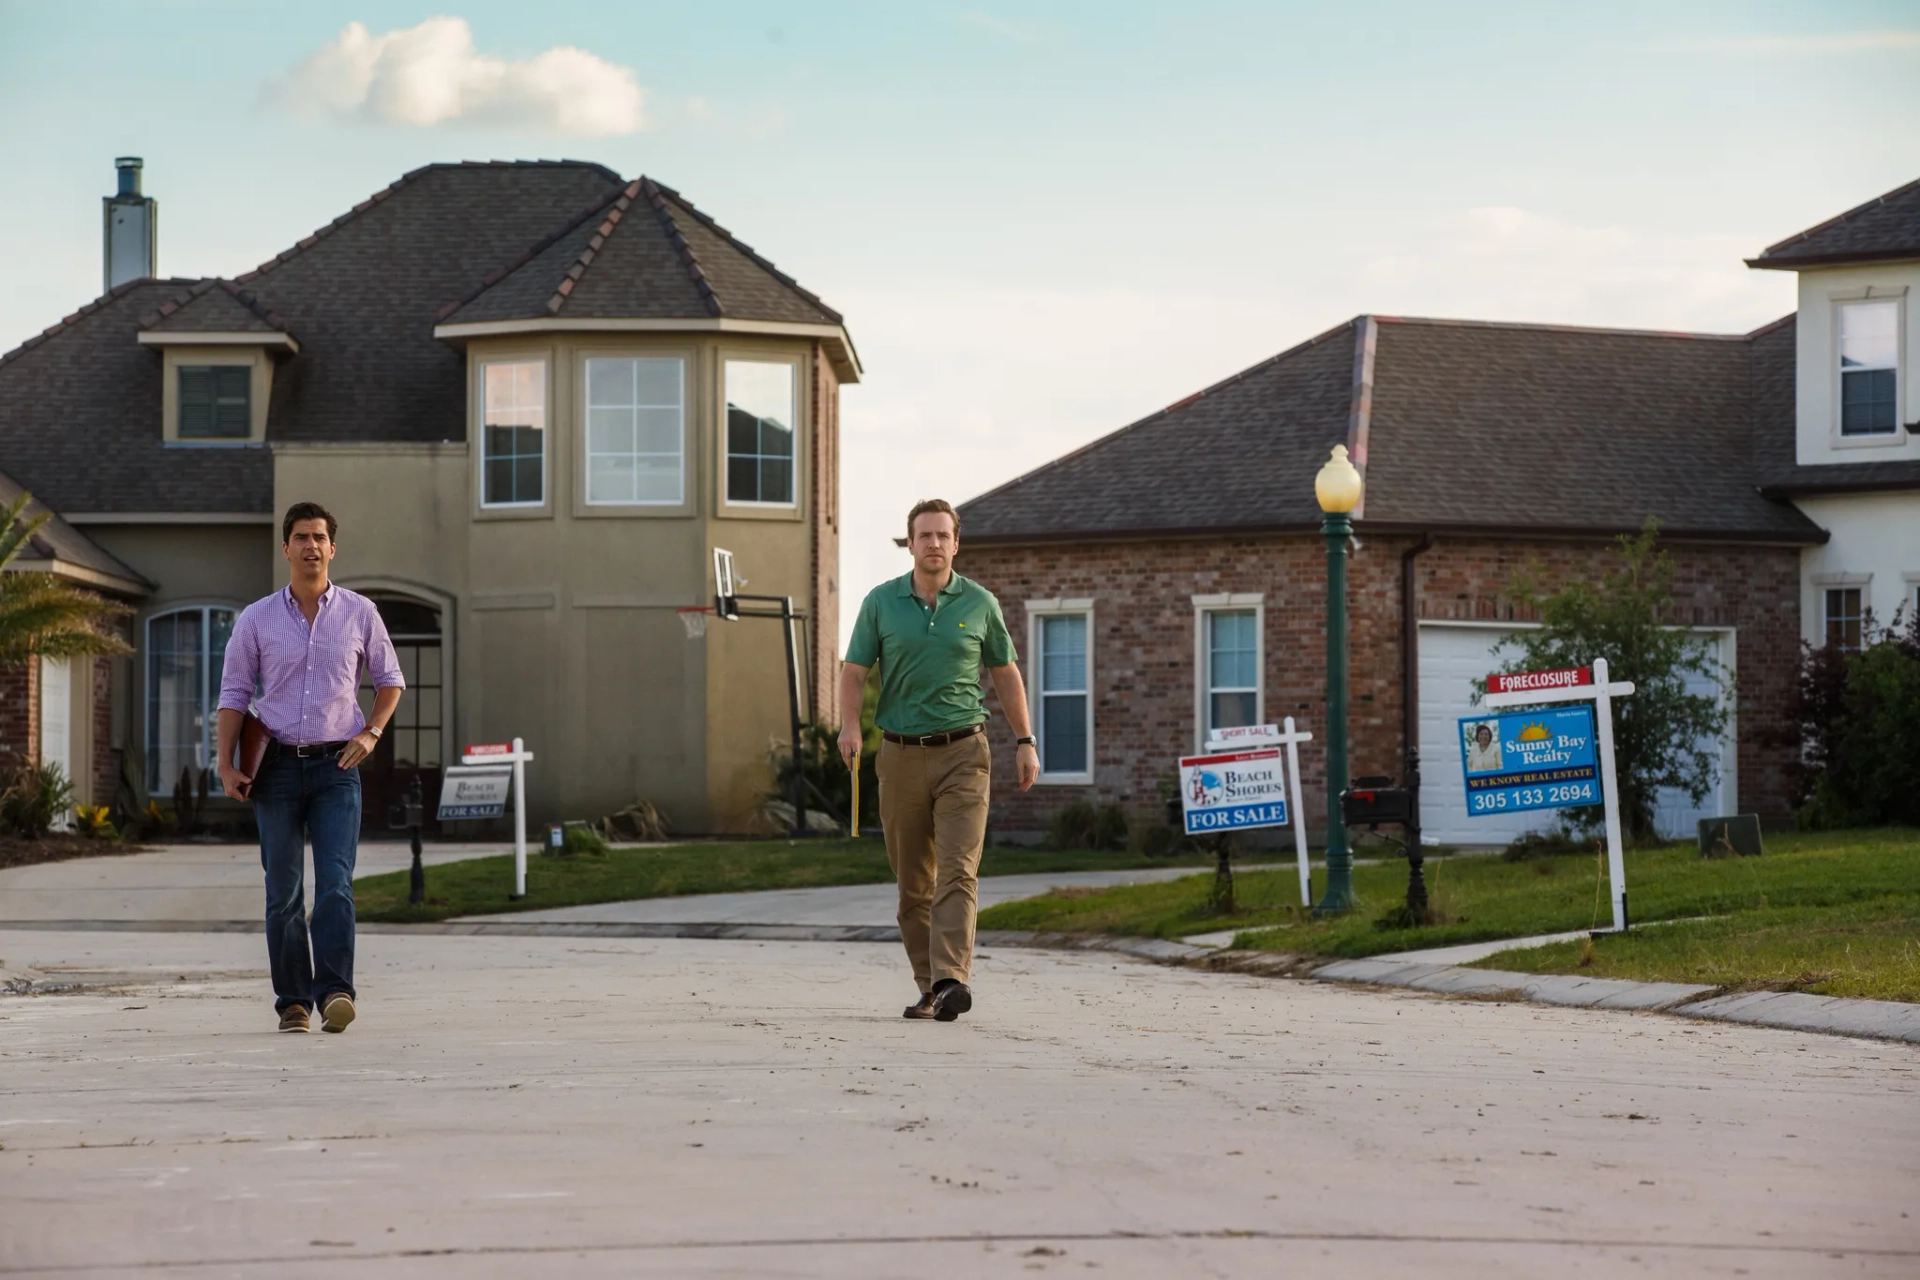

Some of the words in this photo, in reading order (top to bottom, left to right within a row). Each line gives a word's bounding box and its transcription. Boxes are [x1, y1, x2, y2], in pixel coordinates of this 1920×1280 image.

[1499, 670, 1579, 690] FORECLOSURE
[1220, 729, 1246, 738] SHORT
[1249, 727, 1269, 736] SALE
[1506, 739, 1554, 754] Sunny
[1557, 735, 1587, 750] Bay
[1523, 749, 1572, 765] Realty
[1224, 770, 1273, 784] BEACH
[1469, 779, 1487, 788] WE
[1489, 776, 1522, 786] KNOW
[1524, 773, 1552, 783] REAL
[1553, 768, 1593, 779] ESTATE
[1226, 783, 1282, 797] SHORES
[1474, 792, 1507, 810] 305
[1512, 789, 1544, 806] 133
[1549, 784, 1592, 803] 2694
[441, 807, 467, 817] FOR
[469, 805, 502, 816] SALE
[1190, 811, 1230, 829] FOR
[1233, 805, 1284, 824] SALE
